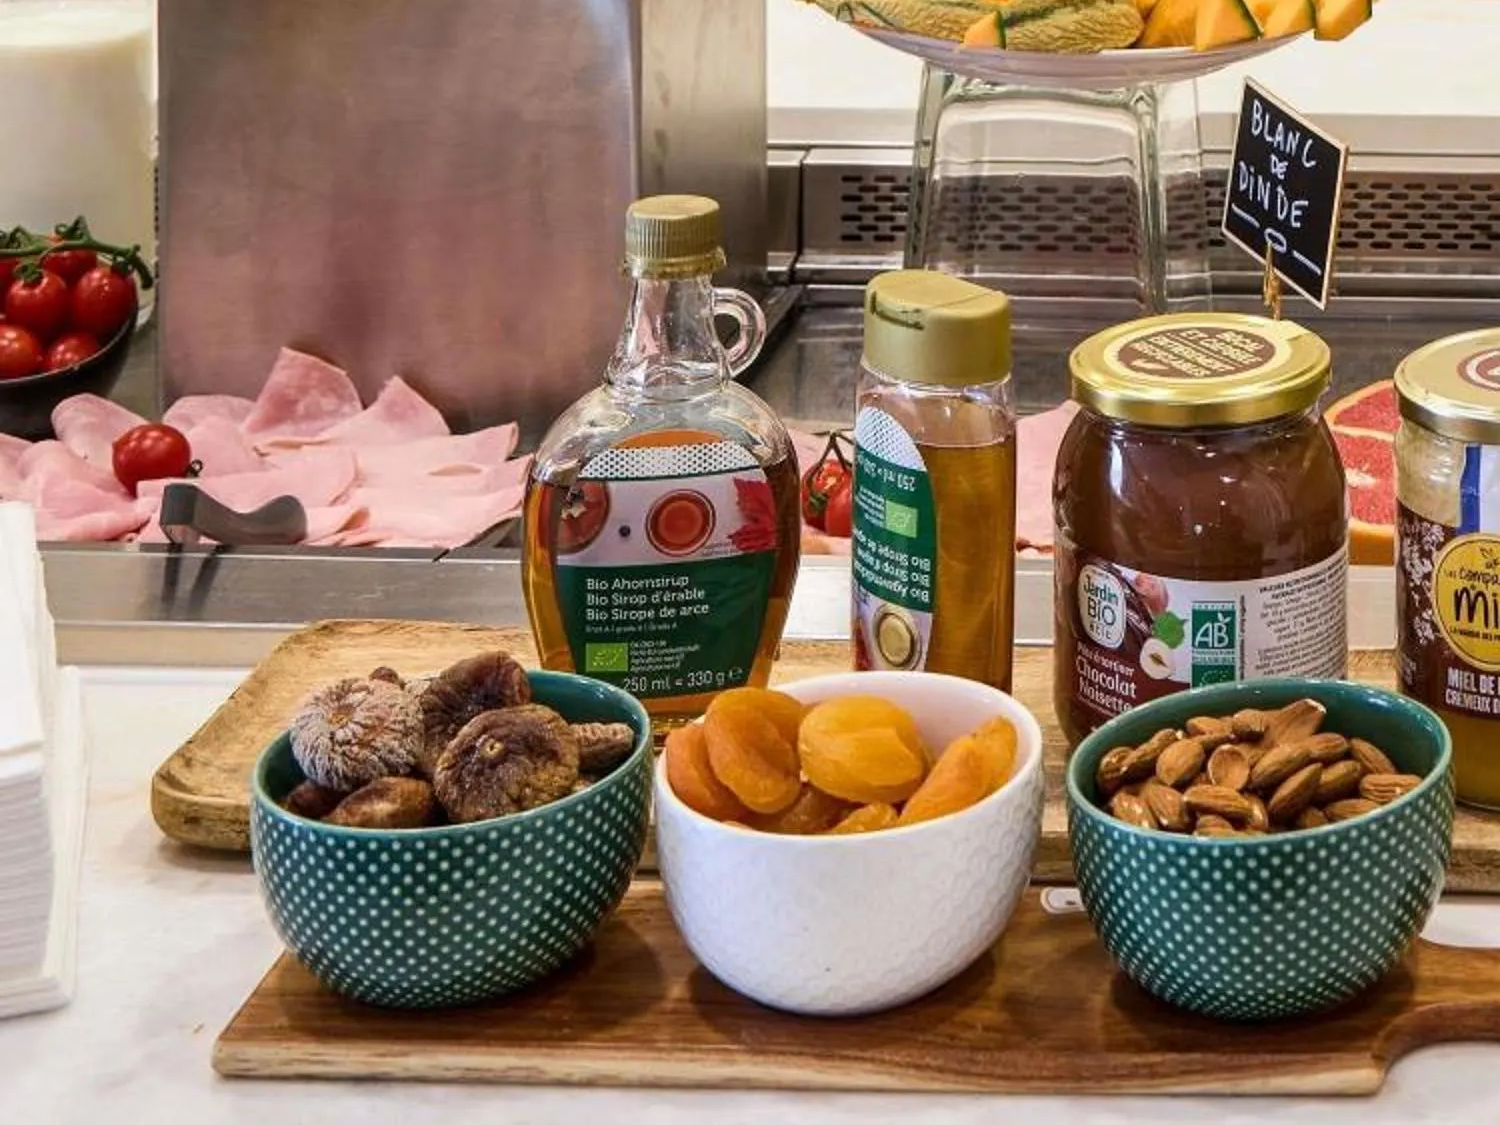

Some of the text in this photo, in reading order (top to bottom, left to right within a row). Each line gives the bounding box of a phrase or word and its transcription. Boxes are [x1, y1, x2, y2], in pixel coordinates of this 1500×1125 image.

[1251, 98, 1317, 168] BLANC
[1269, 153, 1289, 180] DE
[910, 556, 931, 572] Bio
[586, 576, 689, 590] Bio Ahornsirup
[910, 572, 931, 588] Bio
[1084, 574, 1119, 605] Jardin
[586, 587, 705, 606] Bio Sirop d'érable
[910, 588, 930, 603] Bio
[586, 604, 709, 622] Bio Sirope de arce
[1195, 621, 1229, 648] AB
[623, 676, 647, 692] 250
[651, 677, 671, 690] ml
[687, 670, 713, 687] 330
[715, 672, 725, 686] g
[1075, 655, 1137, 699] Chocolat
[1447, 666, 1477, 692] MIEL
[1479, 674, 1495, 695] DE
[1079, 676, 1133, 713] Noisette
